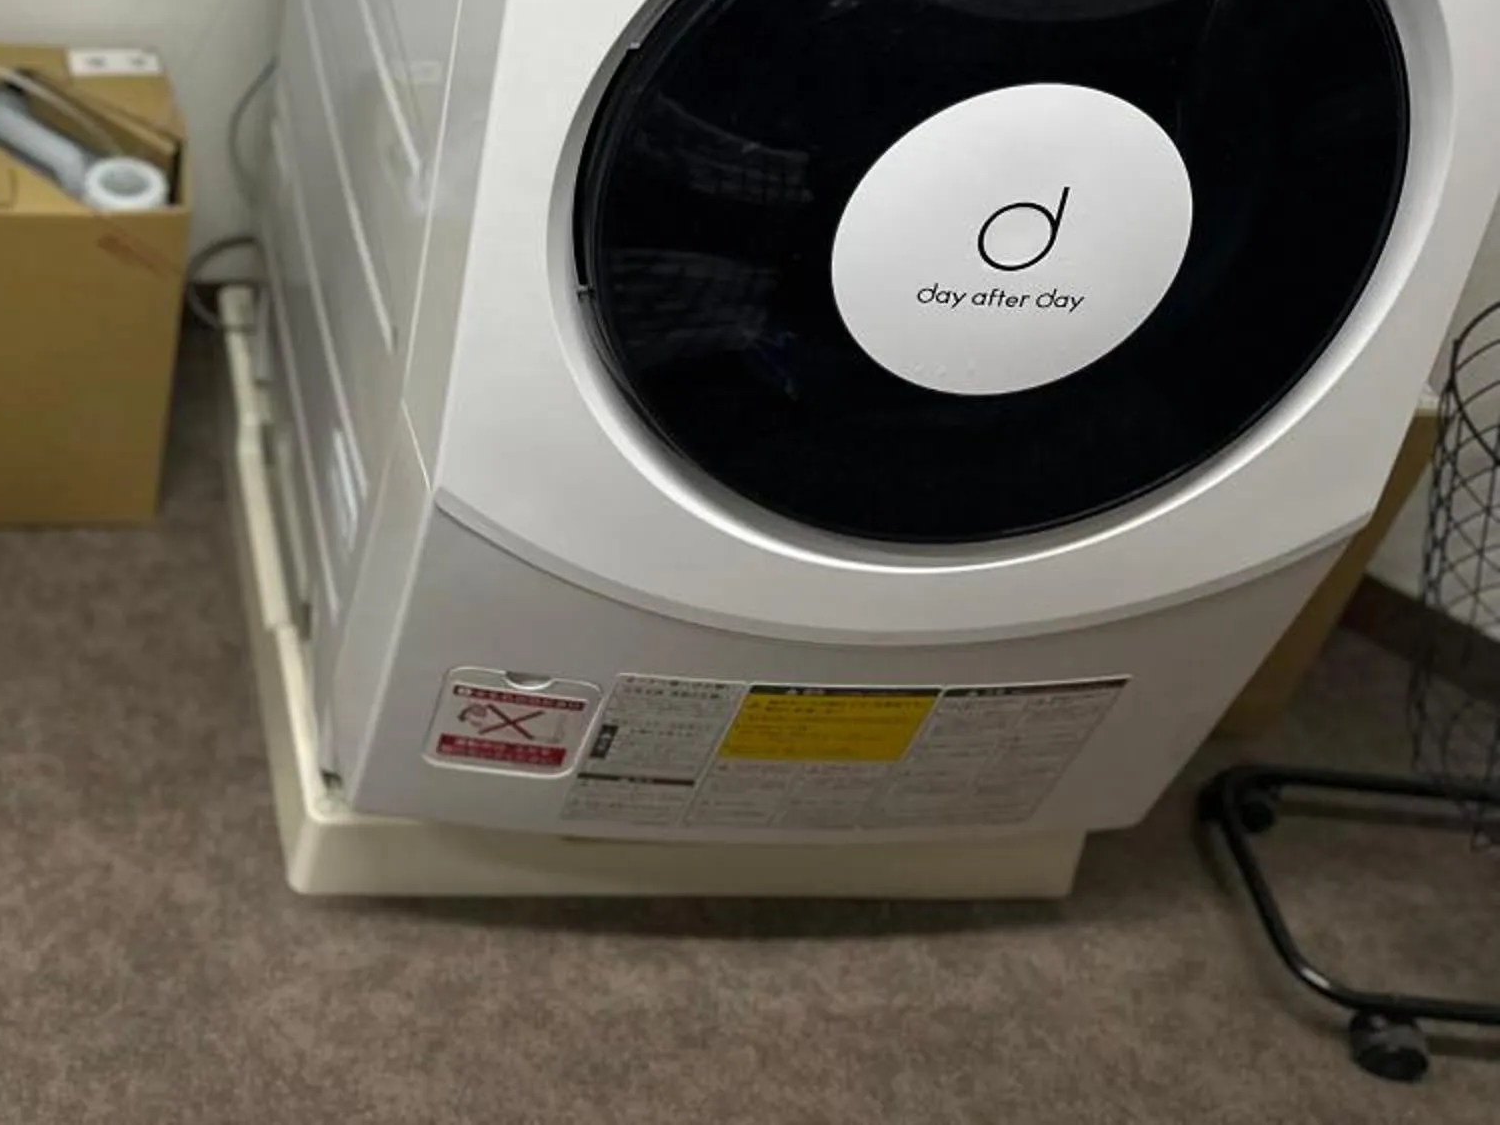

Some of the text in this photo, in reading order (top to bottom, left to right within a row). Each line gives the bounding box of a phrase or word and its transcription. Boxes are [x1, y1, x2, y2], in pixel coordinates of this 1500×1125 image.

[916, 282, 1086, 313] day after day
